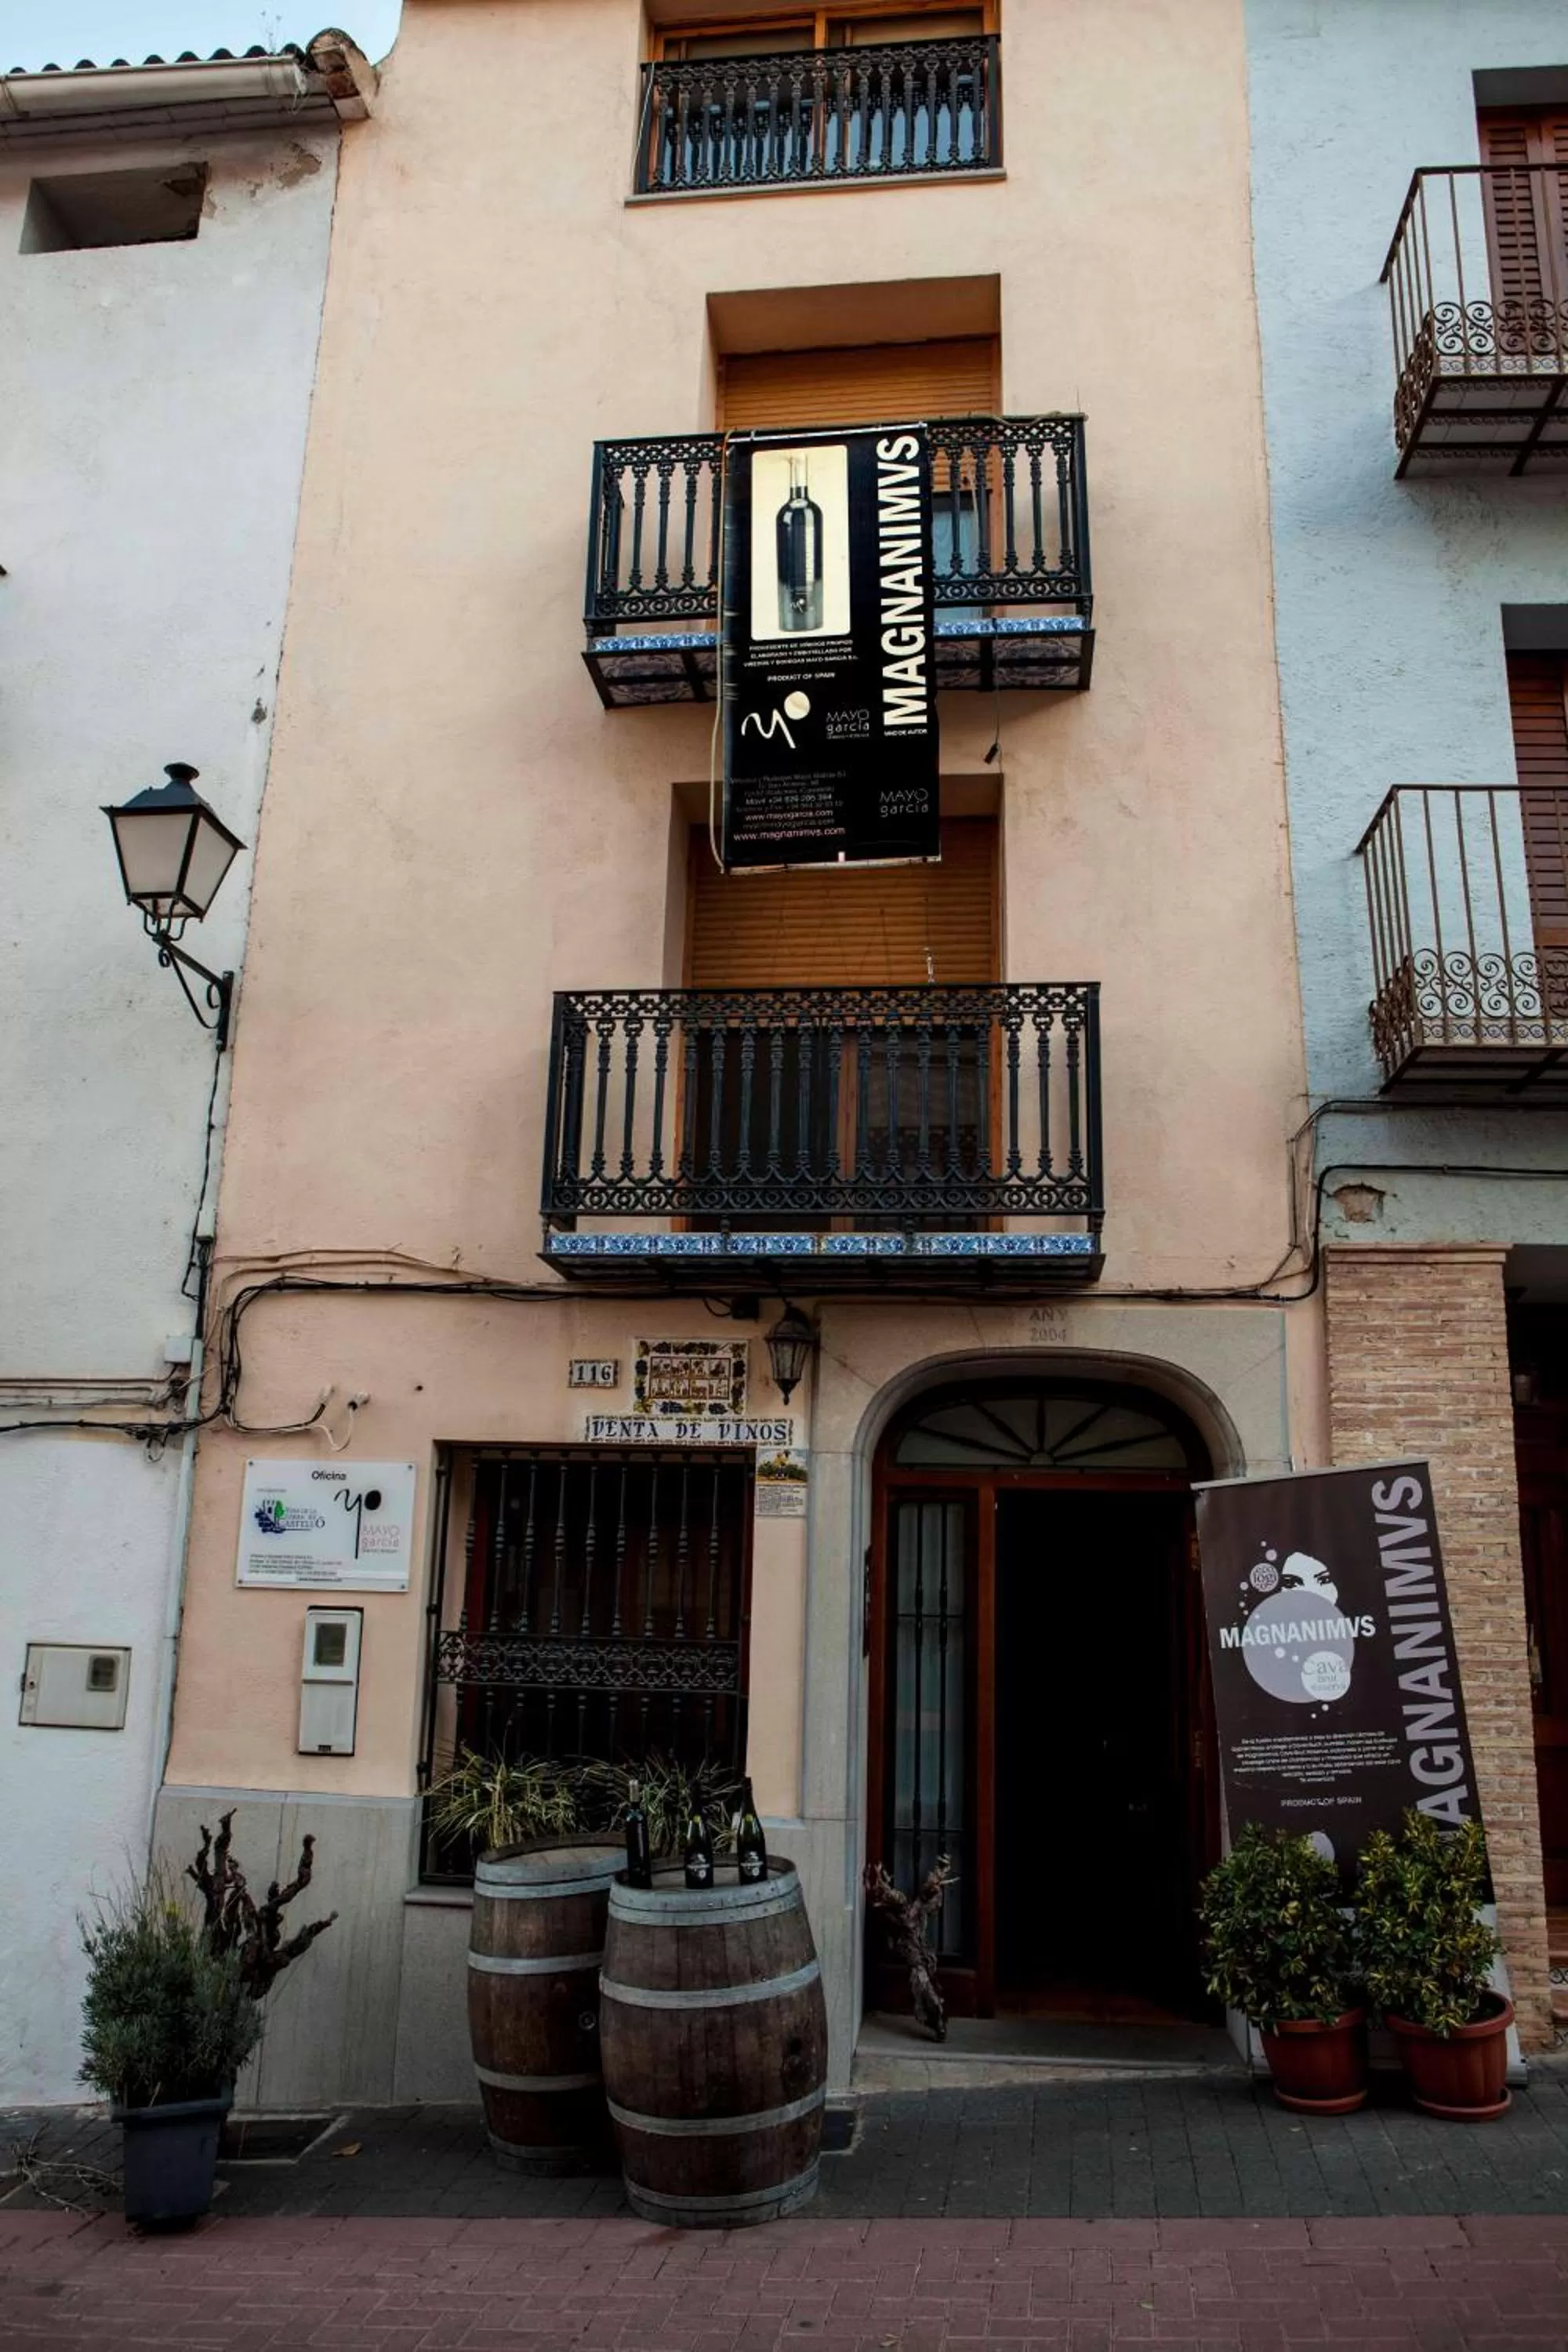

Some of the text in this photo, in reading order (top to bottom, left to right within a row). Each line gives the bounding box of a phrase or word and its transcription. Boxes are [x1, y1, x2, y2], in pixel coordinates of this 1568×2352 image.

[877, 434, 928, 726] MAGNANIMVS
[878, 787, 929, 803] MAYO
[733, 827, 846, 841] www.magnanimvs.com
[576, 1365, 612, 1381] 116
[592, 1420, 786, 1440] VENTA DE VINOS
[311, 1470, 347, 1481] Oficina
[1220, 1615, 1377, 1649] MAGNANIMVS
[1371, 1475, 1472, 1839] AGNANIMVS
